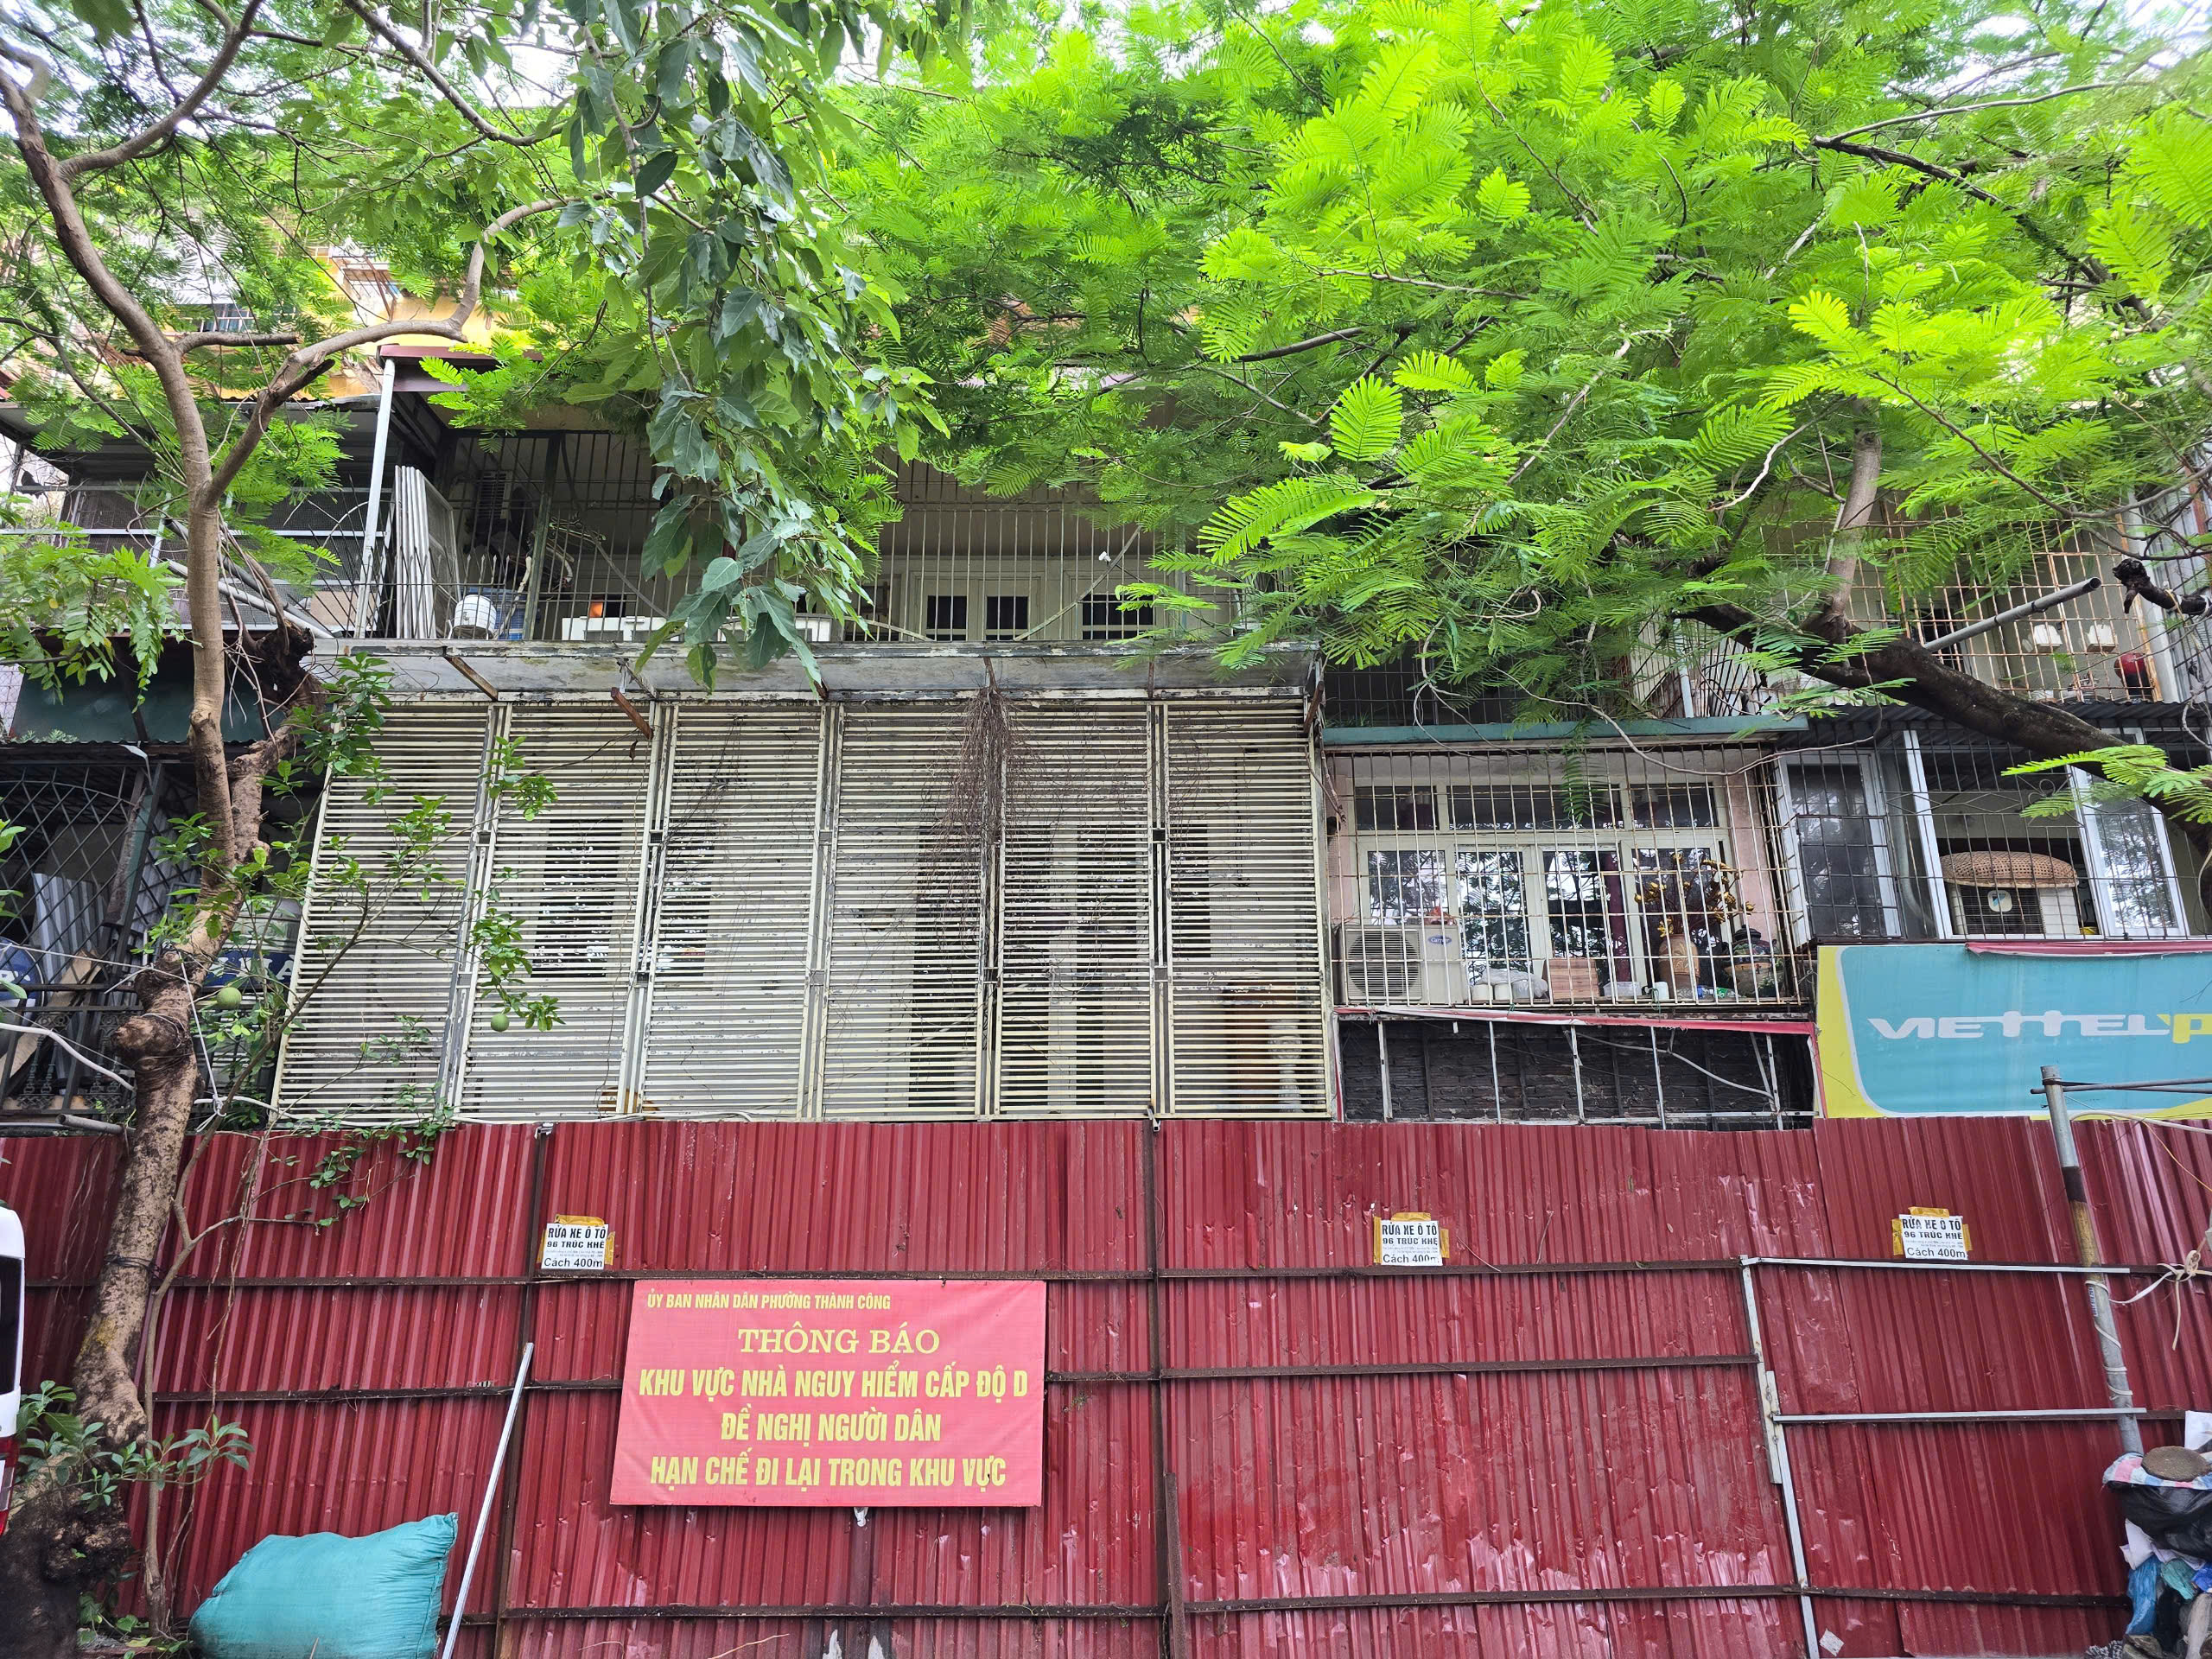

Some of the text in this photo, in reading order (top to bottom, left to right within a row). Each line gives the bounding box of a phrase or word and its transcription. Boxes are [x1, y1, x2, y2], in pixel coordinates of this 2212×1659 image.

[548, 1224, 567, 1238] RỬA
[570, 1229, 582, 1239] XE
[595, 1226, 606, 1239] TÔ
[1382, 1222, 1401, 1236] RỬA
[1403, 1225, 1414, 1236] XE
[1427, 1224, 1437, 1236] TÔ
[1925, 1220, 1937, 1230] XE
[1382, 1254, 1409, 1263] Cách
[1907, 1248, 1966, 1258] Cách 400m
[544, 1257, 602, 1268] Cách 400m
[648, 1288, 891, 1309] ỦY BAN NHÂN DÂN PHƯỜNG THÀNH CÔNG
[738, 1321, 940, 1353] THÔNG BÁO
[639, 1362, 1027, 1403] KHU VỰC NHÀ NGUY HIỂM CẤP ĐỘ D
[721, 1403, 940, 1447] ĐỀ NGHỊ NGƯỜI DÂN
[651, 1447, 1006, 1492] HẠN CHẾ ĐI LẠI TRONG KHU VỰC
